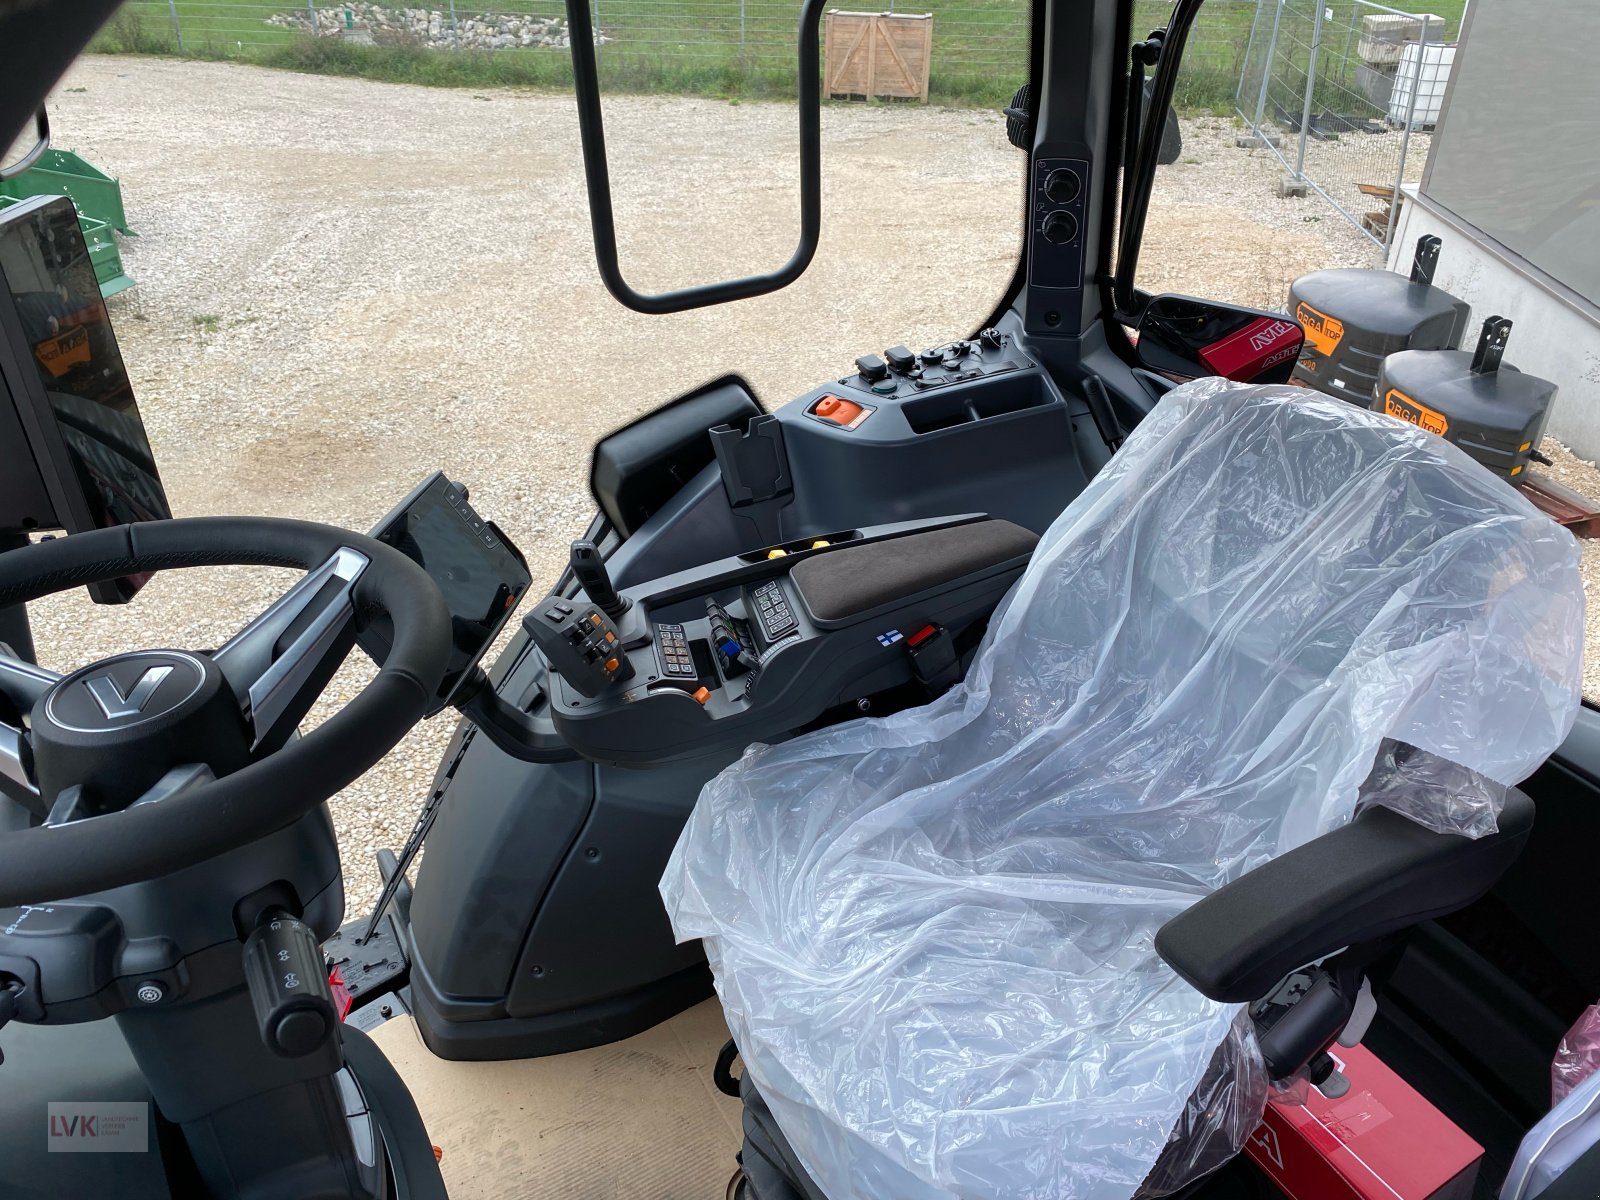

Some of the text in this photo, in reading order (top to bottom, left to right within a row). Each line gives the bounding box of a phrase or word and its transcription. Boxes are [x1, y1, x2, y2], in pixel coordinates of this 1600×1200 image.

[1298, 311, 1342, 341] ORGA TOP
[1388, 399, 1418, 425] ORGA
